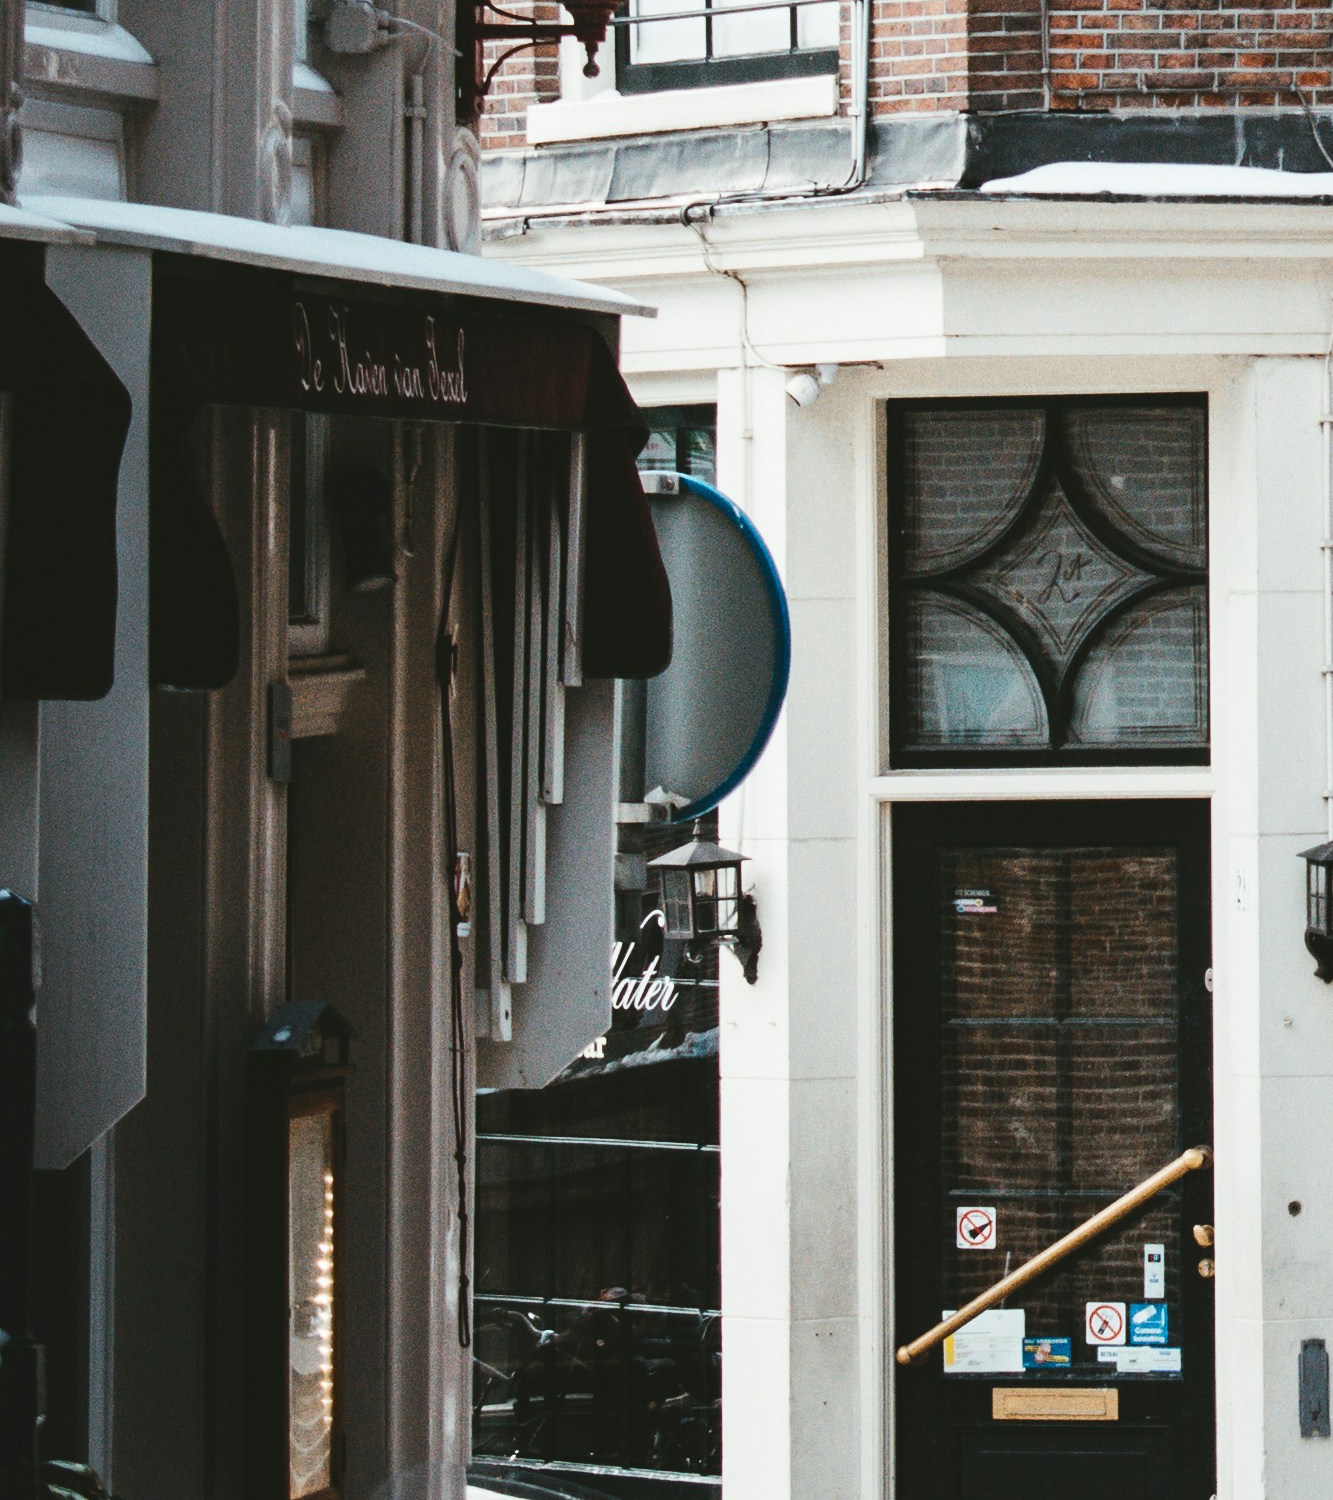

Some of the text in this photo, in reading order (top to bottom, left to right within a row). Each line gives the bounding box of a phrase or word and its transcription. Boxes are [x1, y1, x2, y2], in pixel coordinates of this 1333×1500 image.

[294, 301, 468, 403] De Haven van Texel
